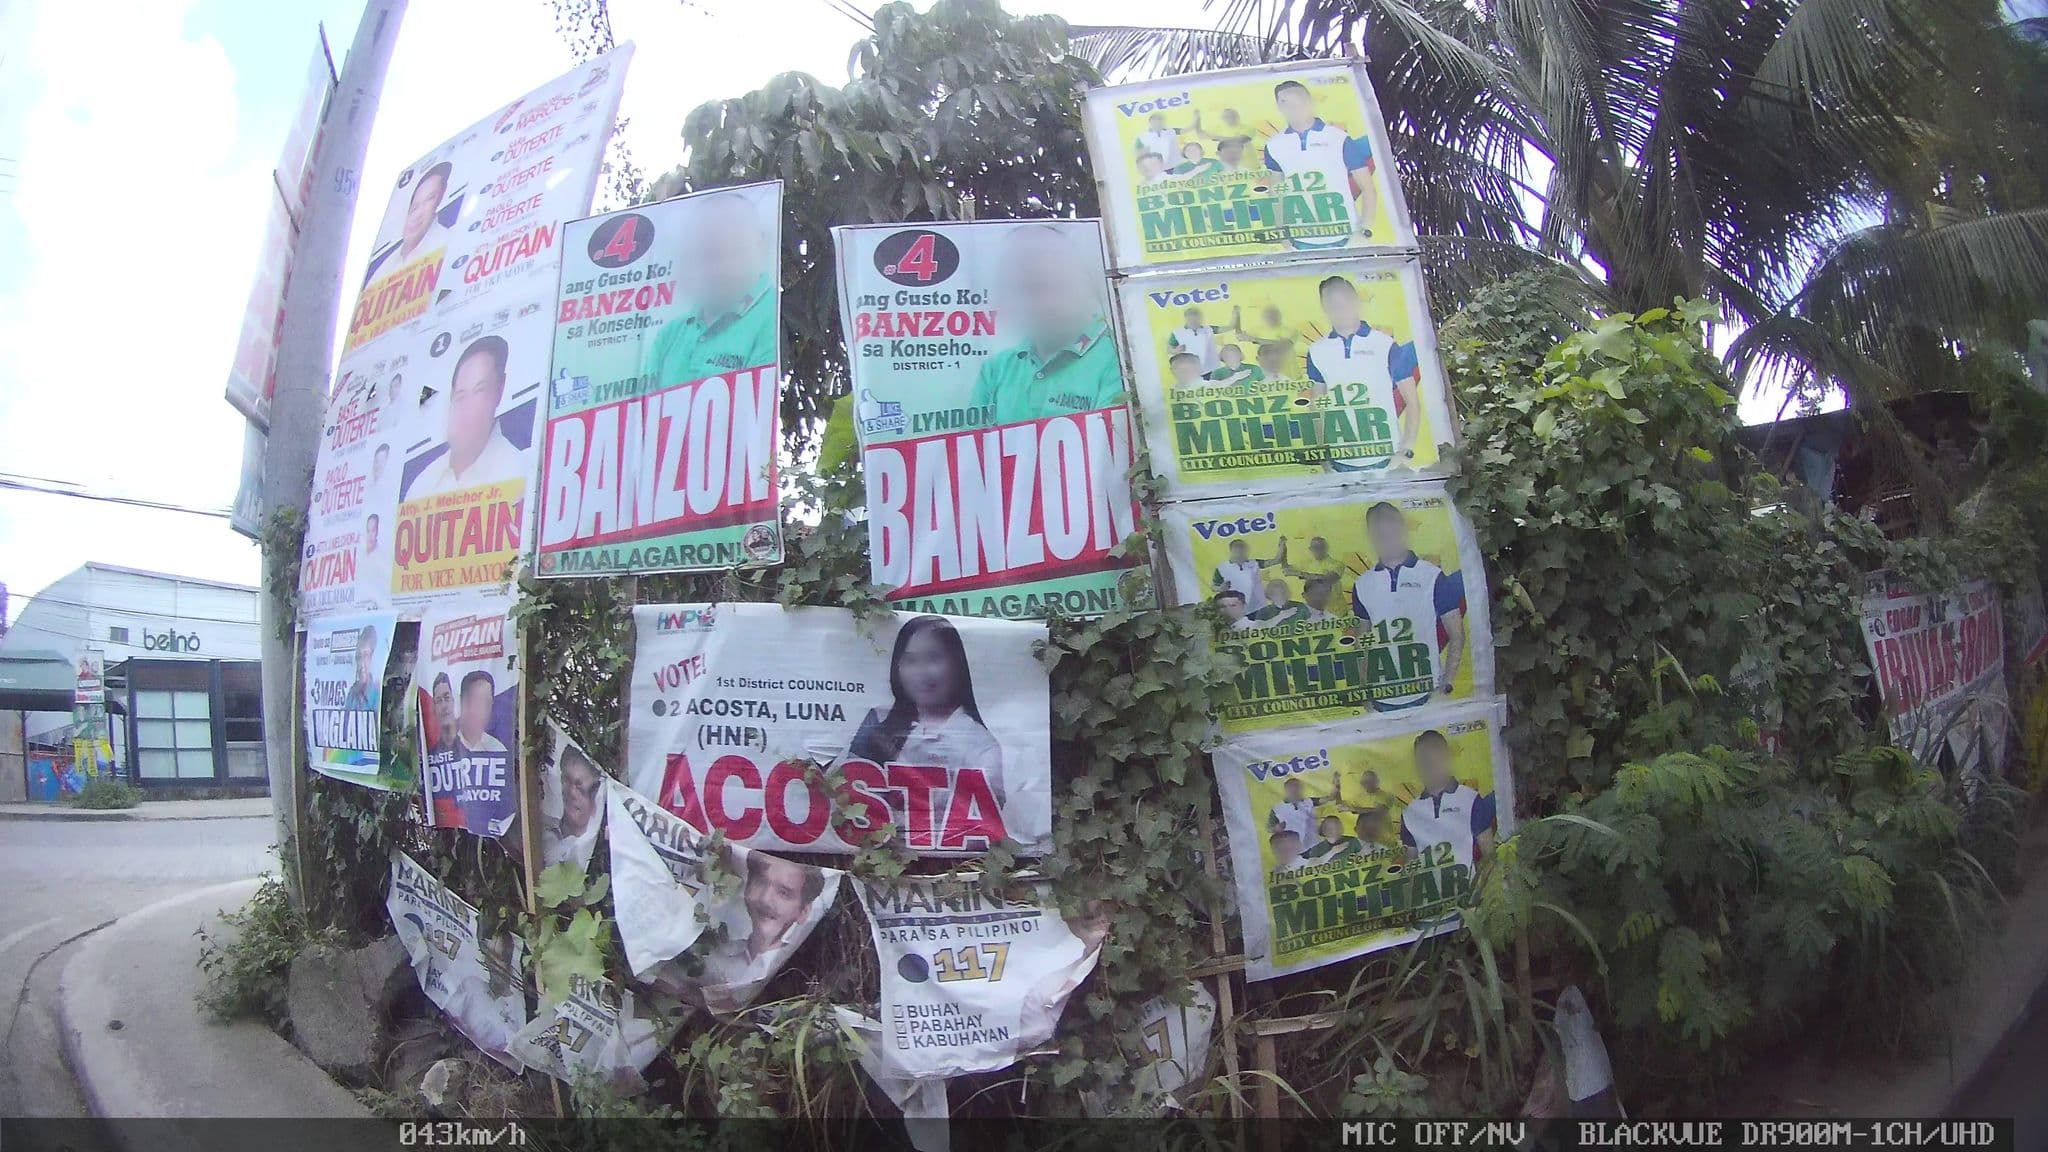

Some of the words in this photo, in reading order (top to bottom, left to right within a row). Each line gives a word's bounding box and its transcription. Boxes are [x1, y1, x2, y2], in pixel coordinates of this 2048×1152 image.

[1117, 92, 1191, 118] Vote!
[492, 155, 554, 197] DUTERTE
[1138, 184, 1249, 212] BONZ
[1274, 171, 1327, 195] #12
[480, 193, 543, 233] DUTERTE
[1141, 192, 1350, 241] MILITAR
[464, 220, 558, 284] QUITAIN
[566, 277, 594, 296] ang
[598, 267, 643, 288] Gusto
[647, 260, 673, 280] Ko!
[351, 258, 444, 334] QUITAIN
[558, 281, 677, 324] BANZON
[895, 290, 951, 306] Gusto
[957, 288, 989, 305] Ko!
[1150, 283, 1231, 309] Vote!
[567, 325, 583, 340] sa
[588, 335, 627, 348] DISTRICT
[855, 310, 997, 342] BANZON
[862, 343, 884, 358] sa
[890, 338, 989, 358] Konseho...
[893, 361, 944, 371] DISTRICT
[595, 371, 660, 403] LYNDON
[1170, 384, 1244, 401] Ipadayon
[1249, 379, 1316, 395] Serbisyo
[1171, 395, 1291, 421] BONZ
[1315, 382, 1370, 408] #12
[876, 416, 905, 429] SHARE
[912, 404, 998, 433] LYNDON
[1176, 407, 1392, 456] MILITAR
[542, 367, 777, 547] BANZON
[1220, 451, 1300, 467] COUNCILOR,
[1303, 448, 1327, 461] 1ST
[1330, 443, 1393, 458] DISTRICT
[865, 408, 1136, 590] BANZON
[394, 498, 525, 571] QUITAIN
[1192, 512, 1277, 540] Vote!
[305, 547, 357, 593] QUITAIN
[561, 542, 742, 572] MAALAGARON!
[401, 573, 423, 591] FOR
[428, 568, 455, 590] VICE
[433, 620, 502, 657] QUITAIN
[1295, 616, 1361, 632] Serbisyo
[1360, 617, 1415, 647] #12
[653, 653, 707, 693] VOTE!
[716, 676, 735, 688] 1st
[739, 677, 784, 690] District
[788, 679, 865, 693] COUNCILOR
[670, 700, 682, 717] 2
[686, 698, 778, 722] ACOSTA,
[786, 701, 847, 721] LUNA
[1263, 694, 1343, 716] COUNCILOR,
[1349, 688, 1369, 703] 1ST
[1372, 680, 1432, 699] DISTRICT
[1247, 749, 1330, 782] Vote!
[657, 753, 1010, 851] ACOSTA
[1269, 864, 1385, 903] BONZ
[1273, 863, 1472, 940] MILITAR
[928, 929, 950, 941] SA
[958, 920, 1040, 938] PILIPINO!
[933, 941, 1011, 983] 117
[907, 1002, 961, 1018] BUHAY
[910, 1015, 983, 1034] PABAHAY
[914, 1027, 1010, 1048] KABUHAYAN
